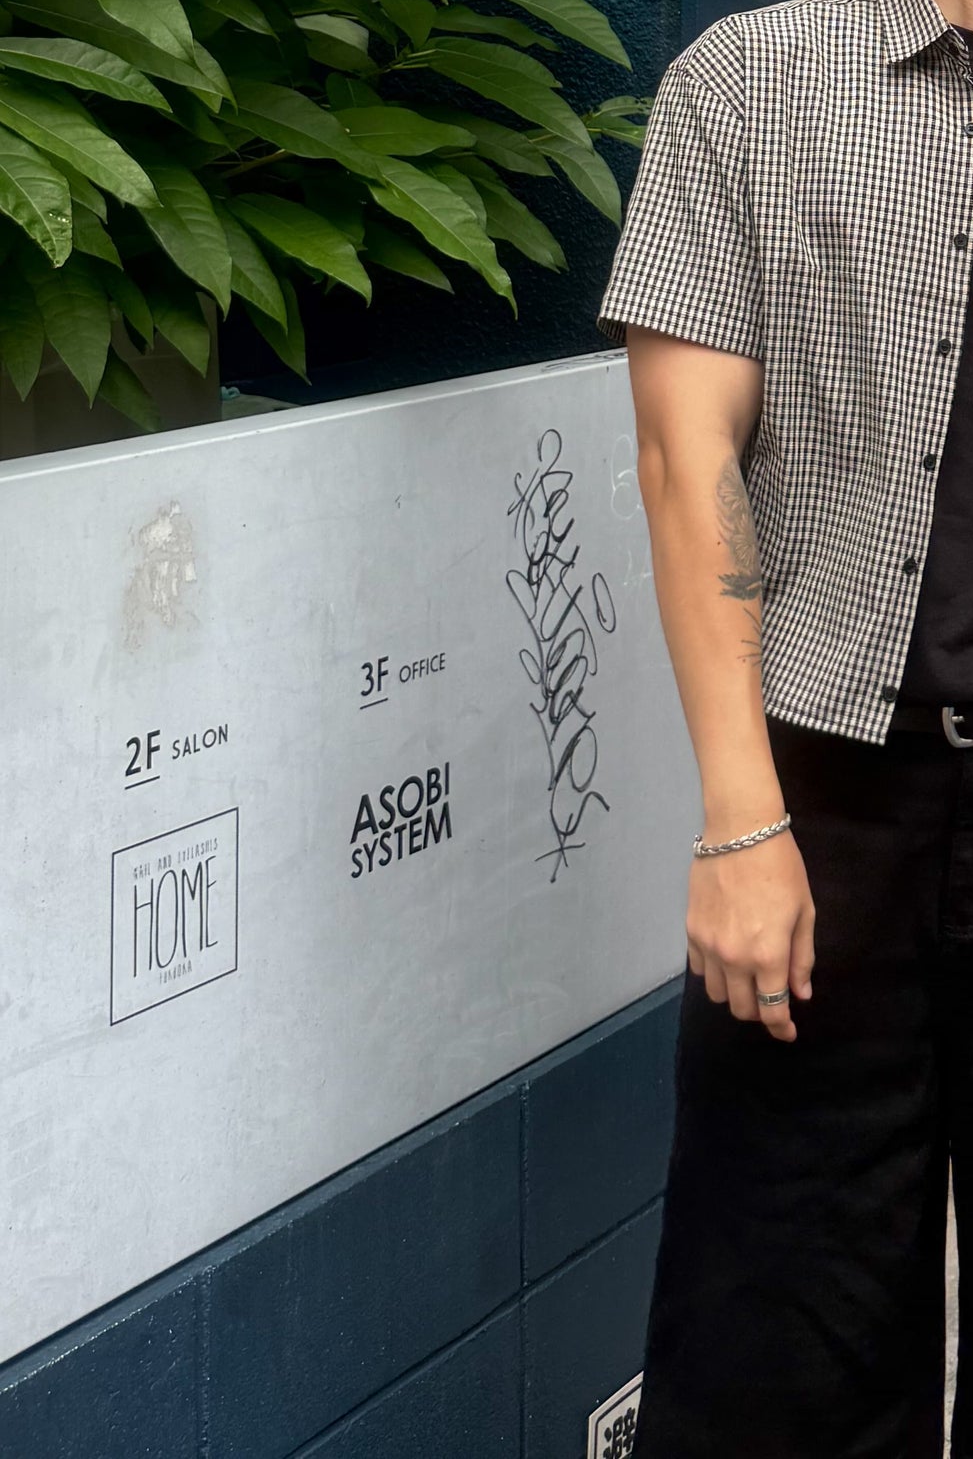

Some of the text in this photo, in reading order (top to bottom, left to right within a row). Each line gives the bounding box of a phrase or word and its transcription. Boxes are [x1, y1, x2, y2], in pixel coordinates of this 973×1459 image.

[360, 652, 446, 697] 3F OFFICE
[125, 723, 228, 777] 2F SALON
[350, 761, 450, 844] ASOBI
[350, 801, 453, 879] SYSTEM
[133, 855, 218, 978] HOME
